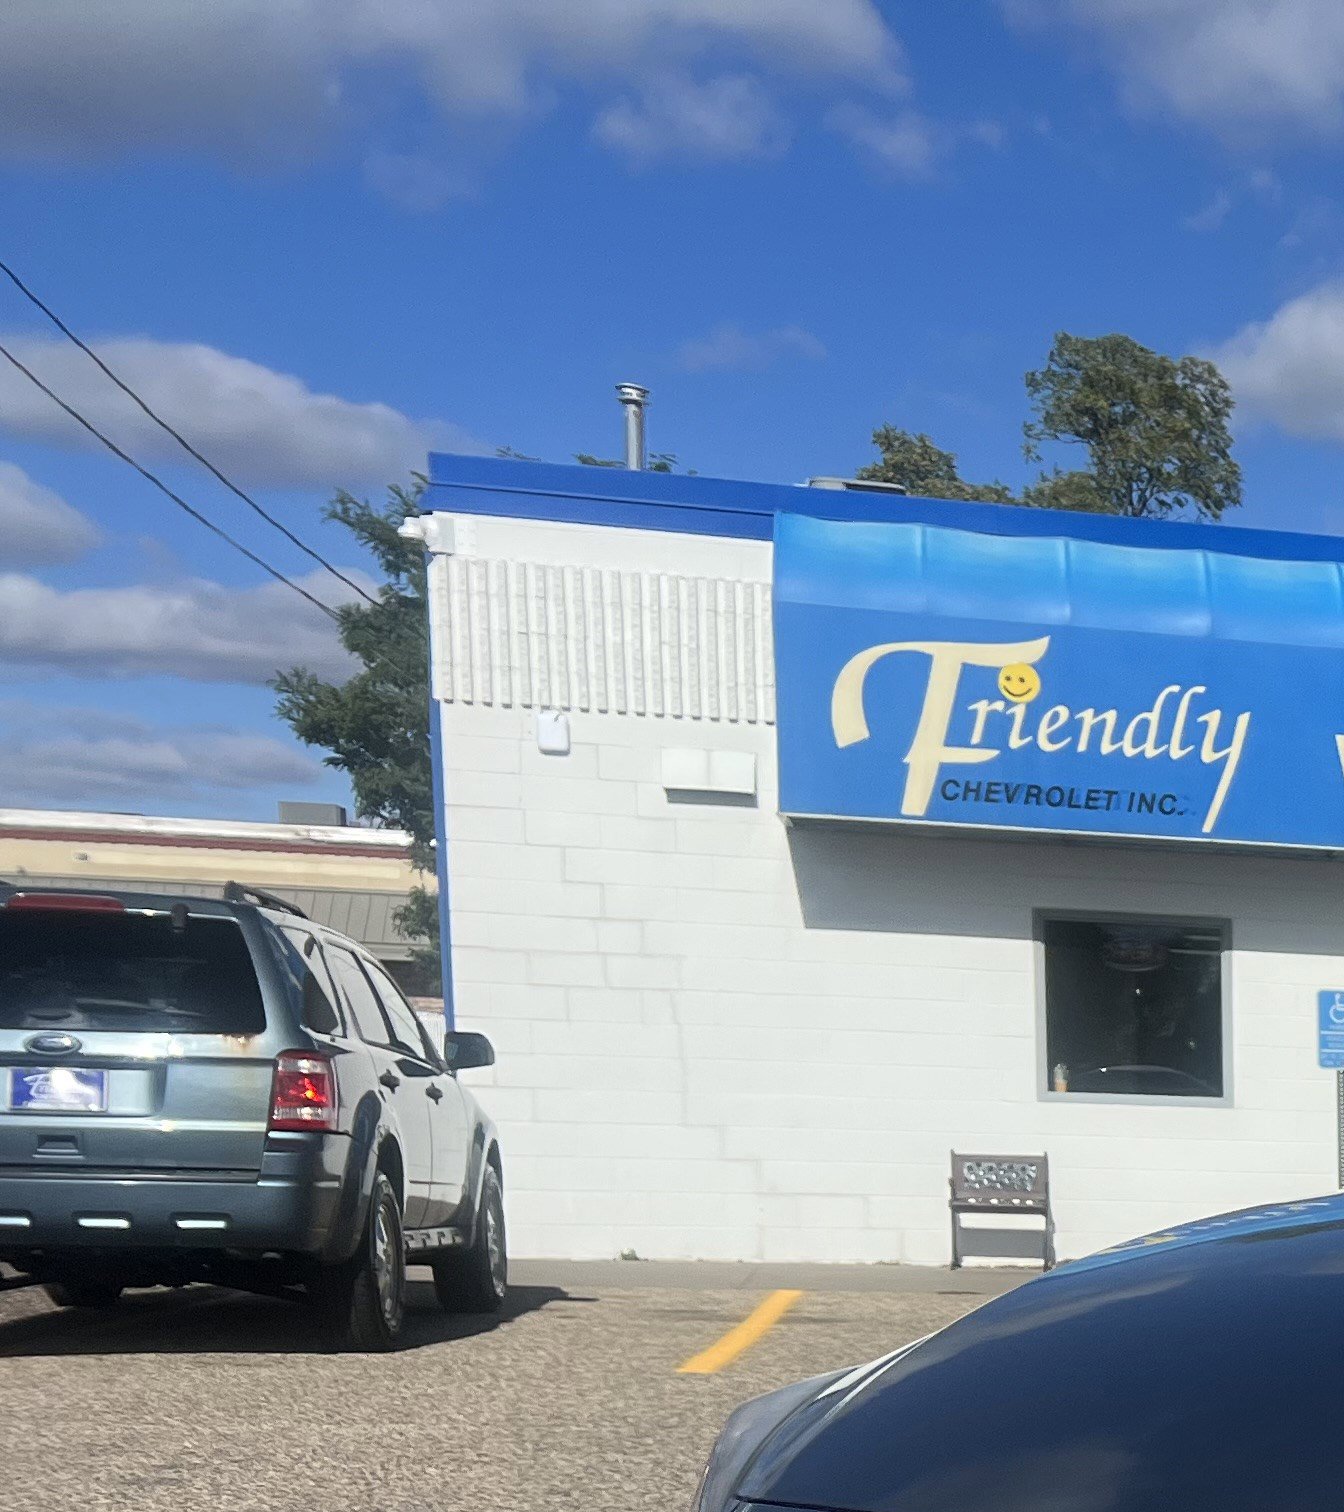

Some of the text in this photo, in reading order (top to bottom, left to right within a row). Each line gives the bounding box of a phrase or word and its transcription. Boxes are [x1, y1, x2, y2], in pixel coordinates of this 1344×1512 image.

[831, 635, 1250, 833] Friendly
[940, 779, 1186, 816] CHEVROLET INC.
